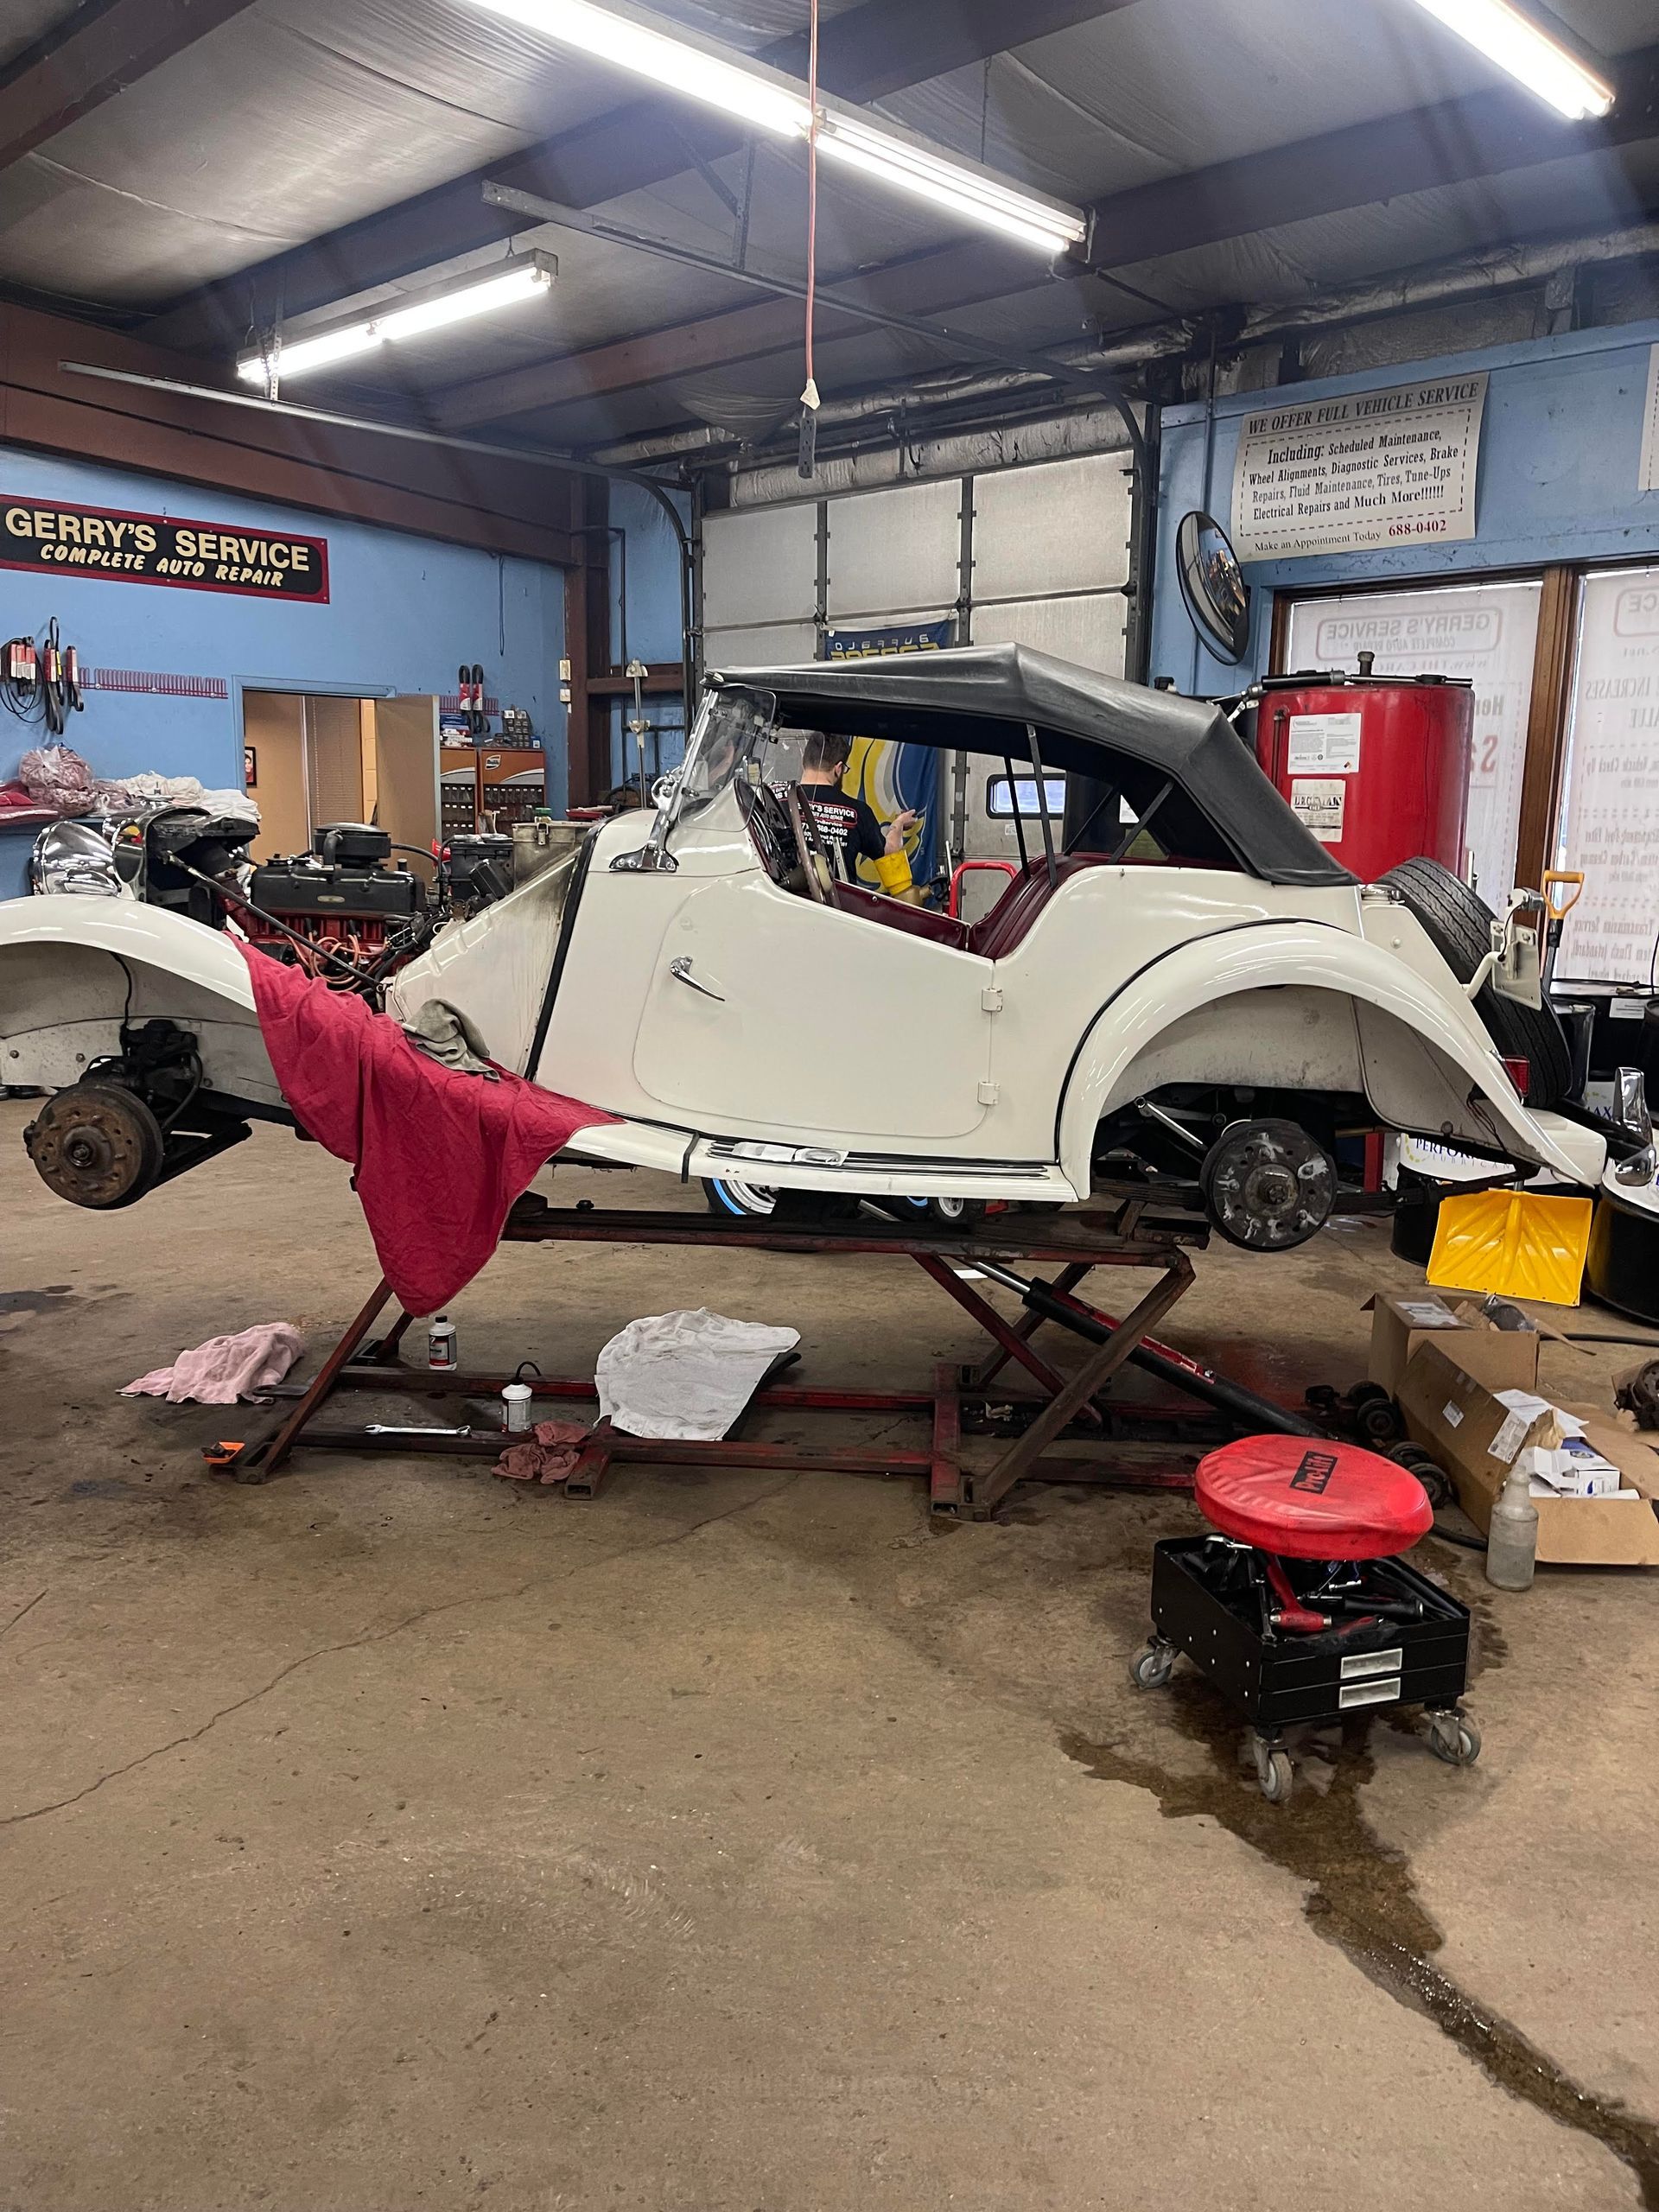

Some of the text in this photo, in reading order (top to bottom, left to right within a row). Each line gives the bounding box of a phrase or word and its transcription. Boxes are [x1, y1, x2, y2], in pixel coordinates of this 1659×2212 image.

[1249, 382, 1478, 434] WE OFFER FULL VEHICLE SERVICE
[1249, 444, 1459, 486] Wheel Alignments, Diagnostic Services, Brake
[1268, 428, 1442, 464] Including: Scheduled Maintenance,
[1252, 466, 1451, 504] Repairs, Fluid Maintenance, Tires, Tune-Ups
[1253, 503, 1294, 520] Electrical
[1297, 499, 1331, 518] Repairs
[1334, 498, 1351, 512] and
[1354, 492, 1386, 508] Much
[5, 507, 309, 572] GERRY'S SERVICE
[1255, 519, 1447, 552] Make an Appointment Today 688-0402
[40, 543, 283, 587] COMPLETE AUTO REPAIR
[823, 806, 855, 818] SERVICE
